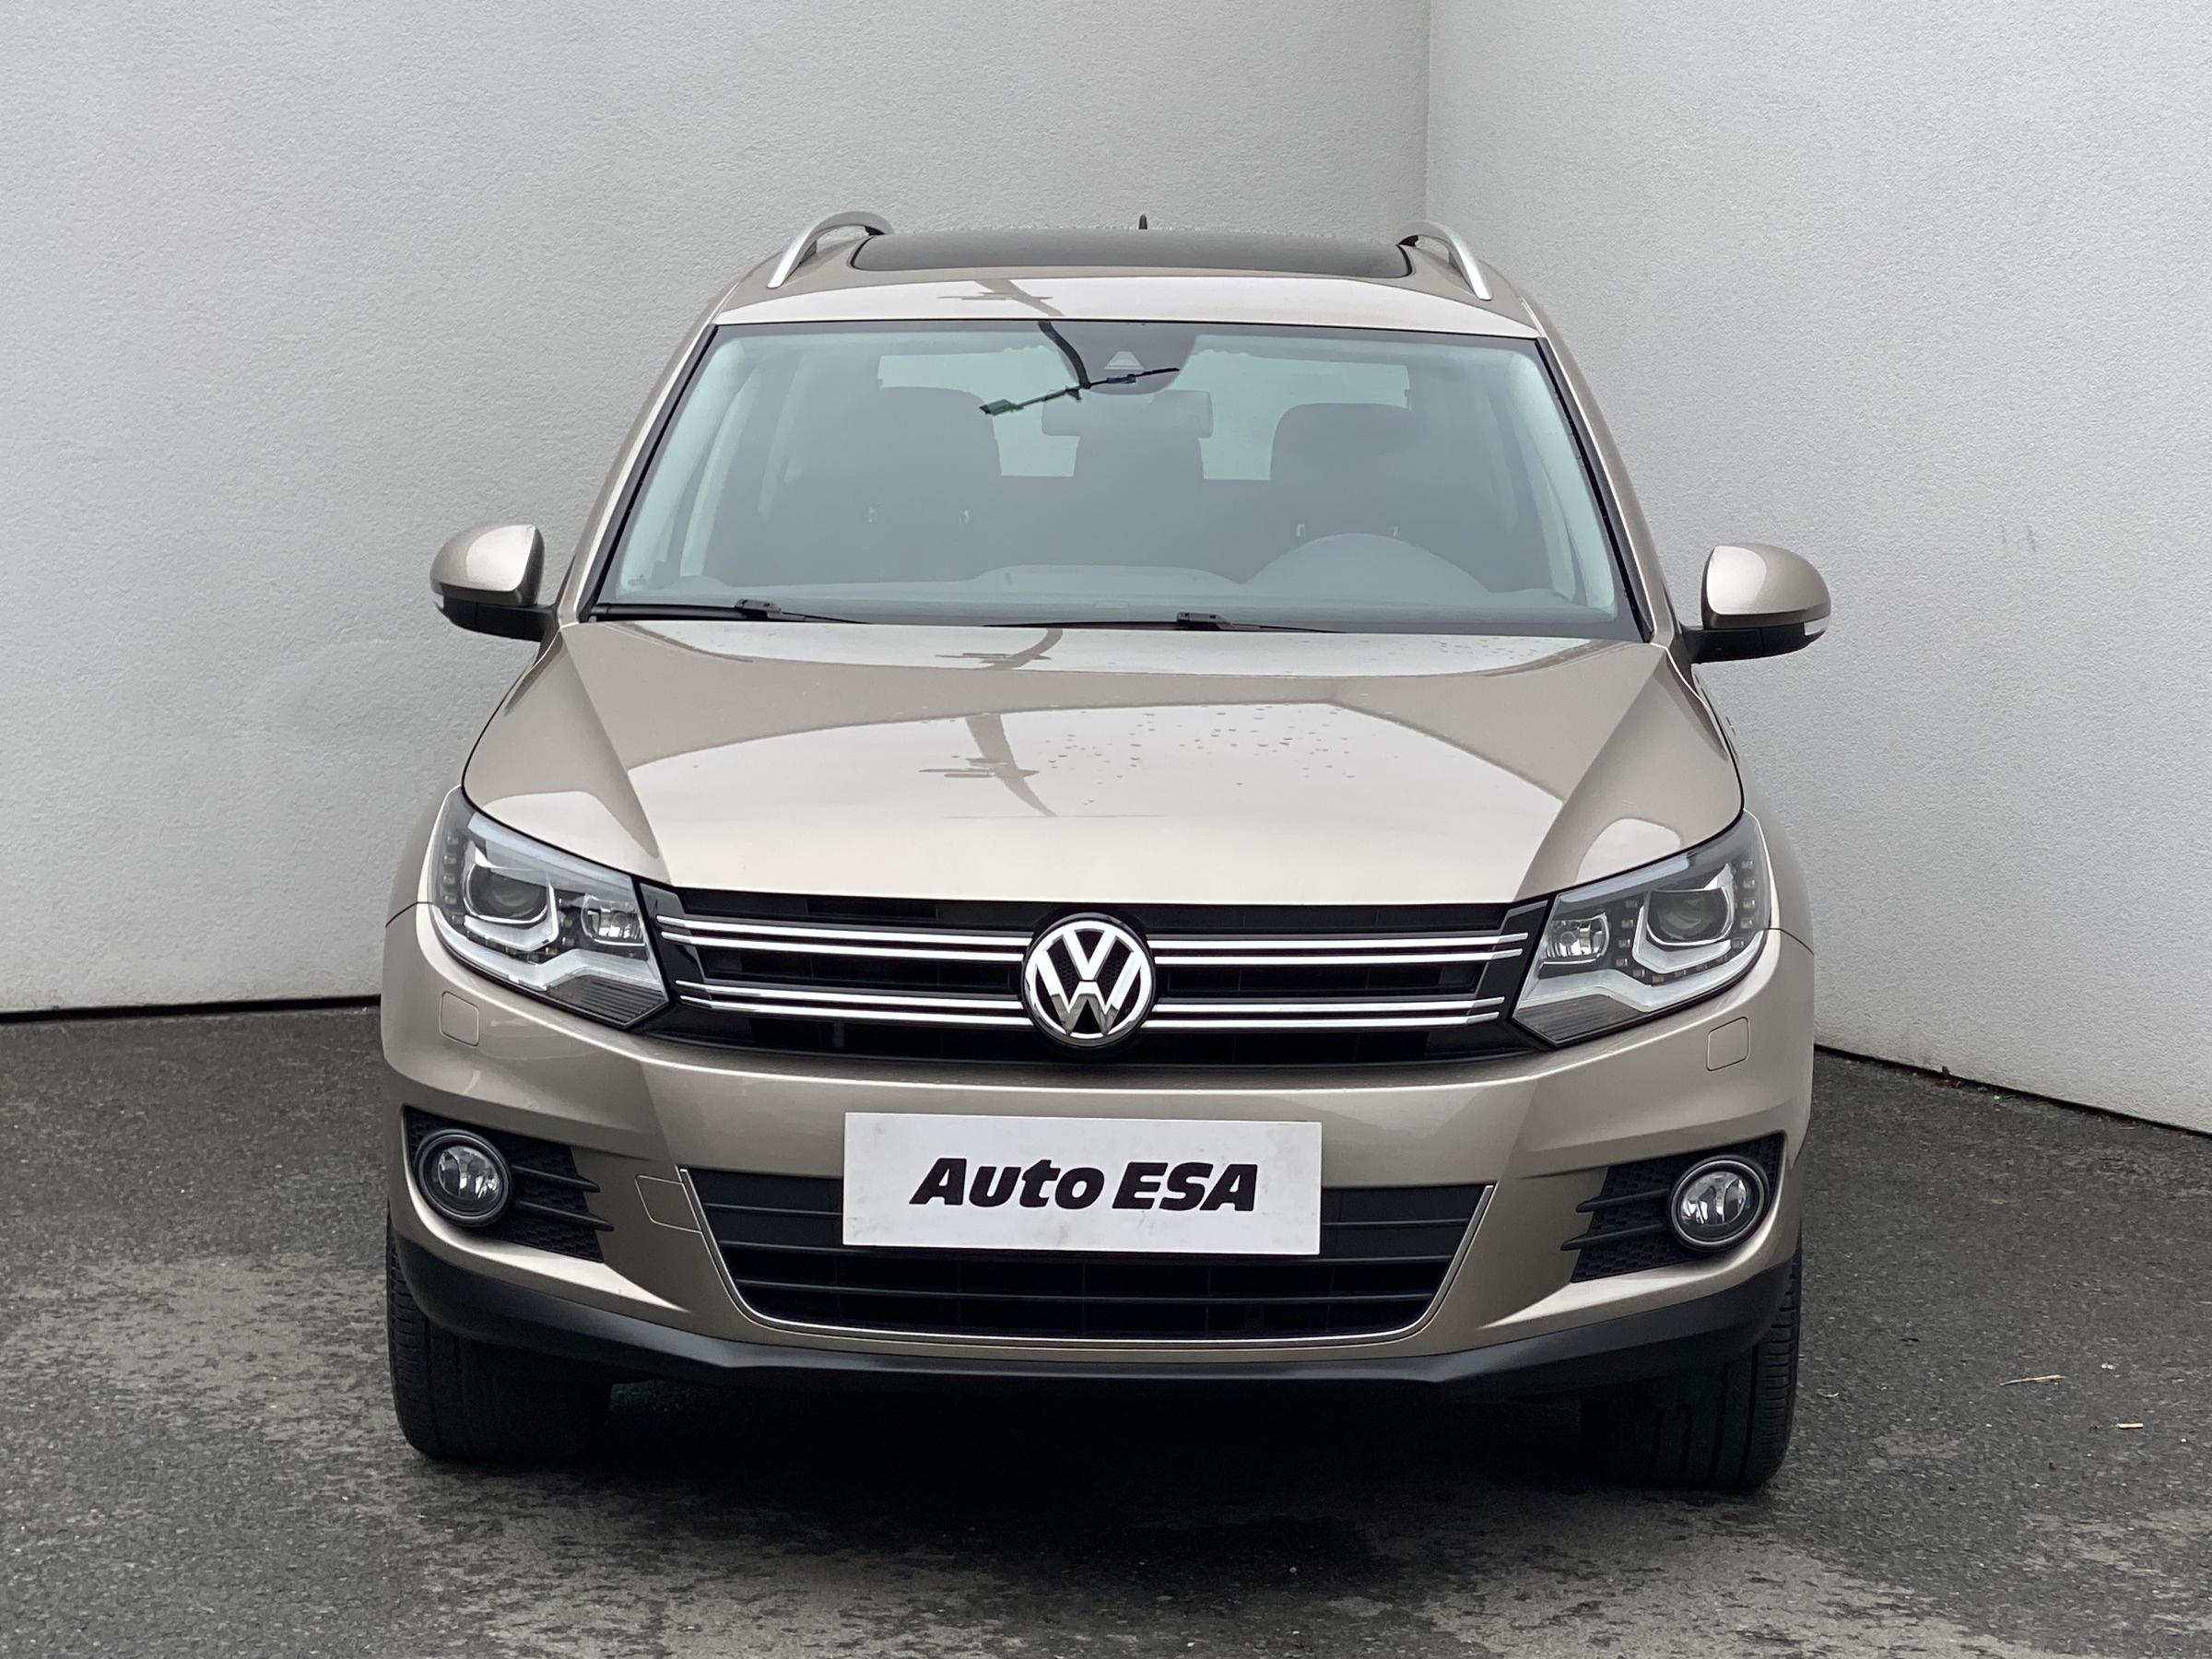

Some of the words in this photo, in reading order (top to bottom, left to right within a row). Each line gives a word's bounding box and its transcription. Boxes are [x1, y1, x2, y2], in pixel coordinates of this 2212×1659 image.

[1025, 919, 1152, 1040] VW
[909, 1157, 1105, 1210] Auto
[1112, 1161, 1258, 1212] ESA
